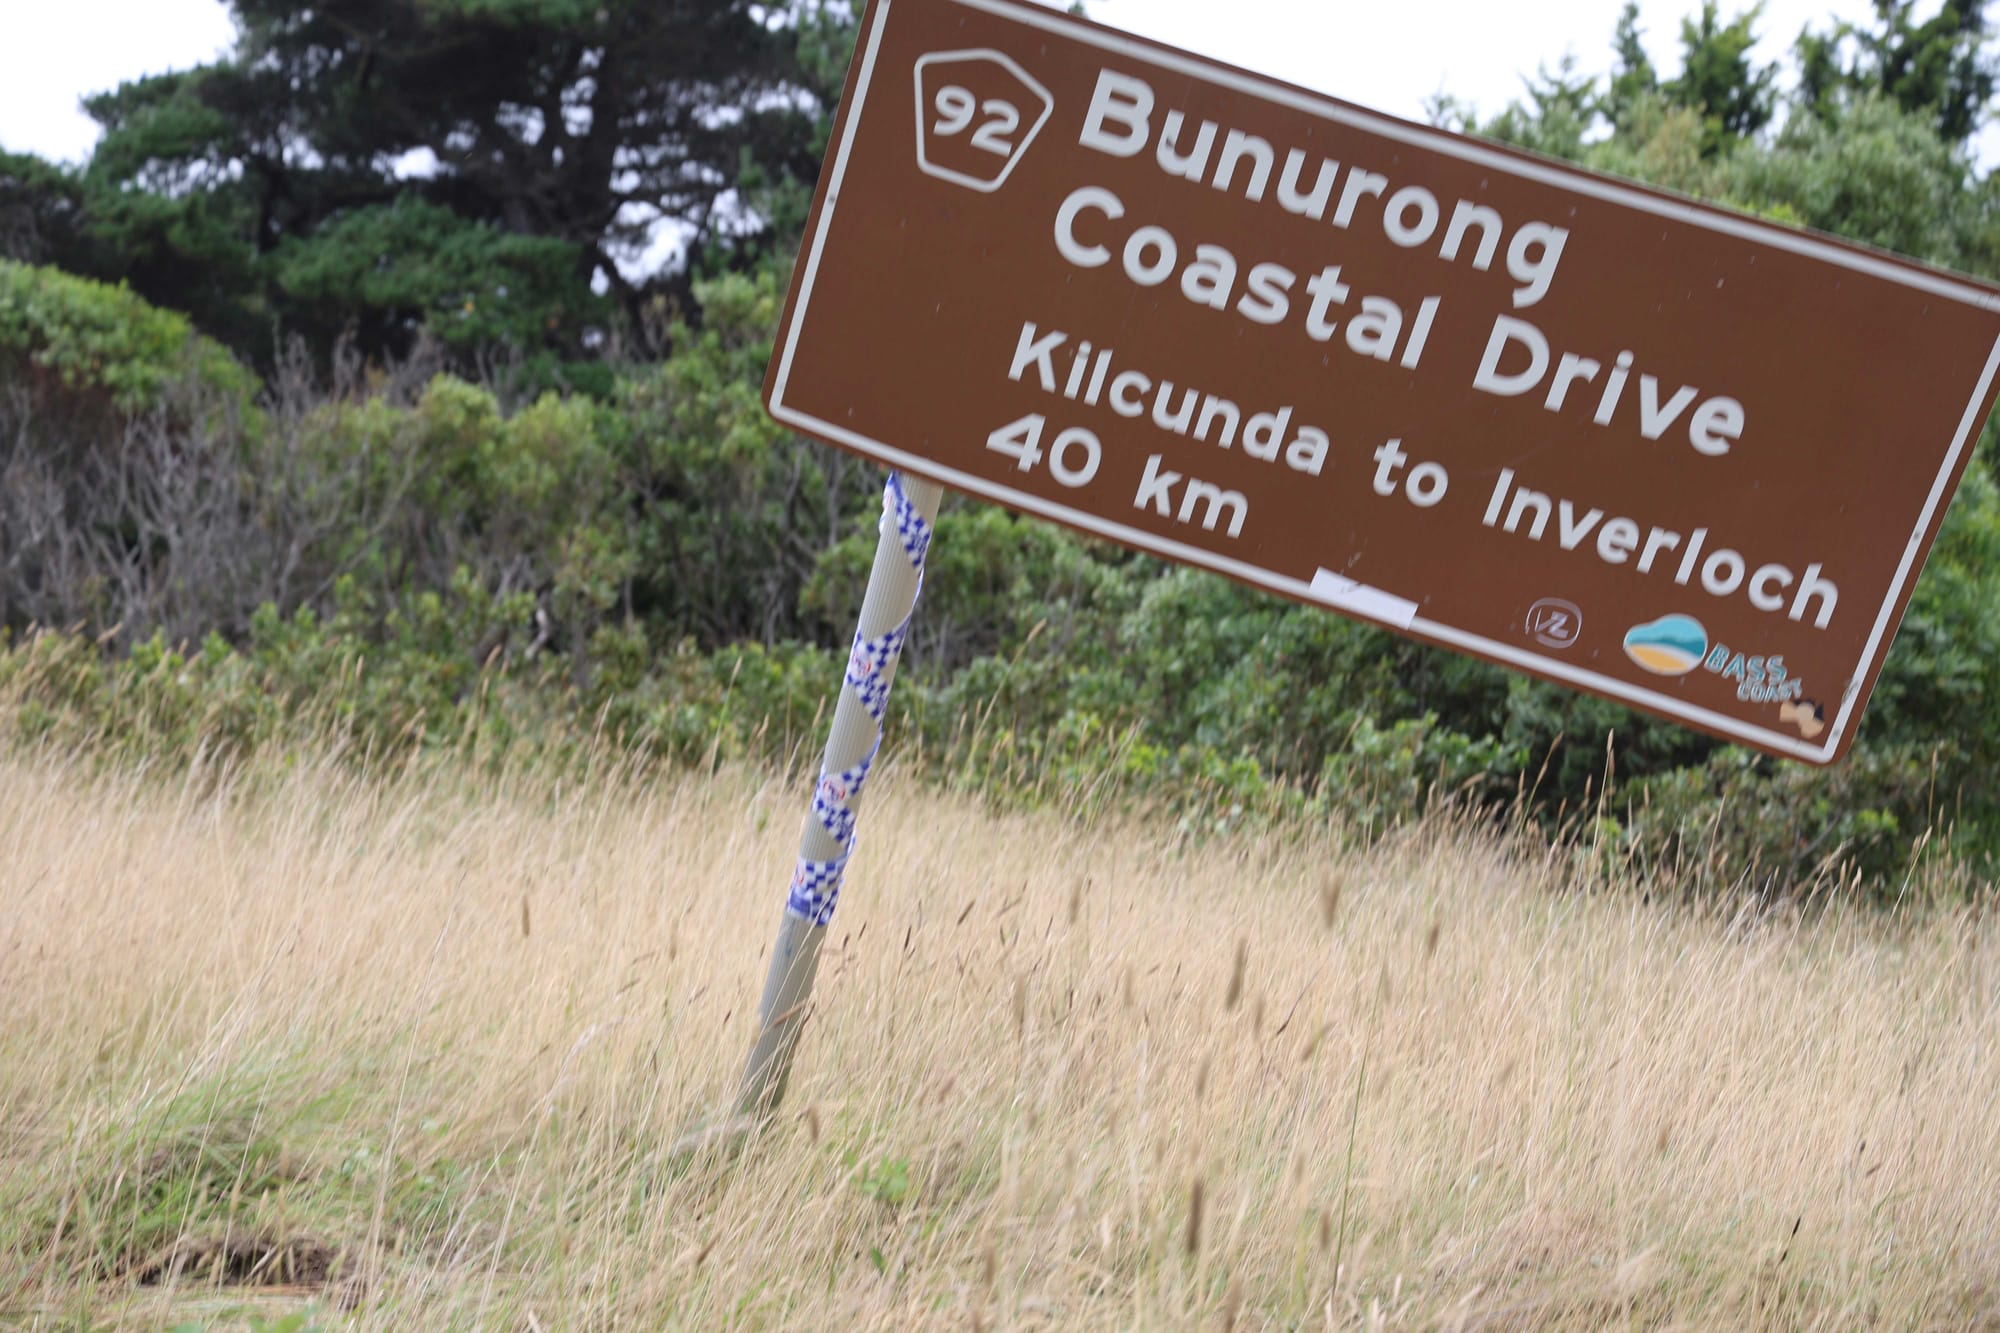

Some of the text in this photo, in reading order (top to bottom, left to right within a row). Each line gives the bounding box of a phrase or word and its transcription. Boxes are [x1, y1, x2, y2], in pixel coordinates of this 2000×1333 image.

[934, 87, 1019, 156] 92
[1078, 68, 1569, 307] Bunurong
[1054, 186, 1745, 455] Coastal Drive
[986, 413, 1248, 538] 40 km
[1008, 321, 1839, 629] Kilcunda to Inverloch
[1704, 642, 1788, 683] BASS
